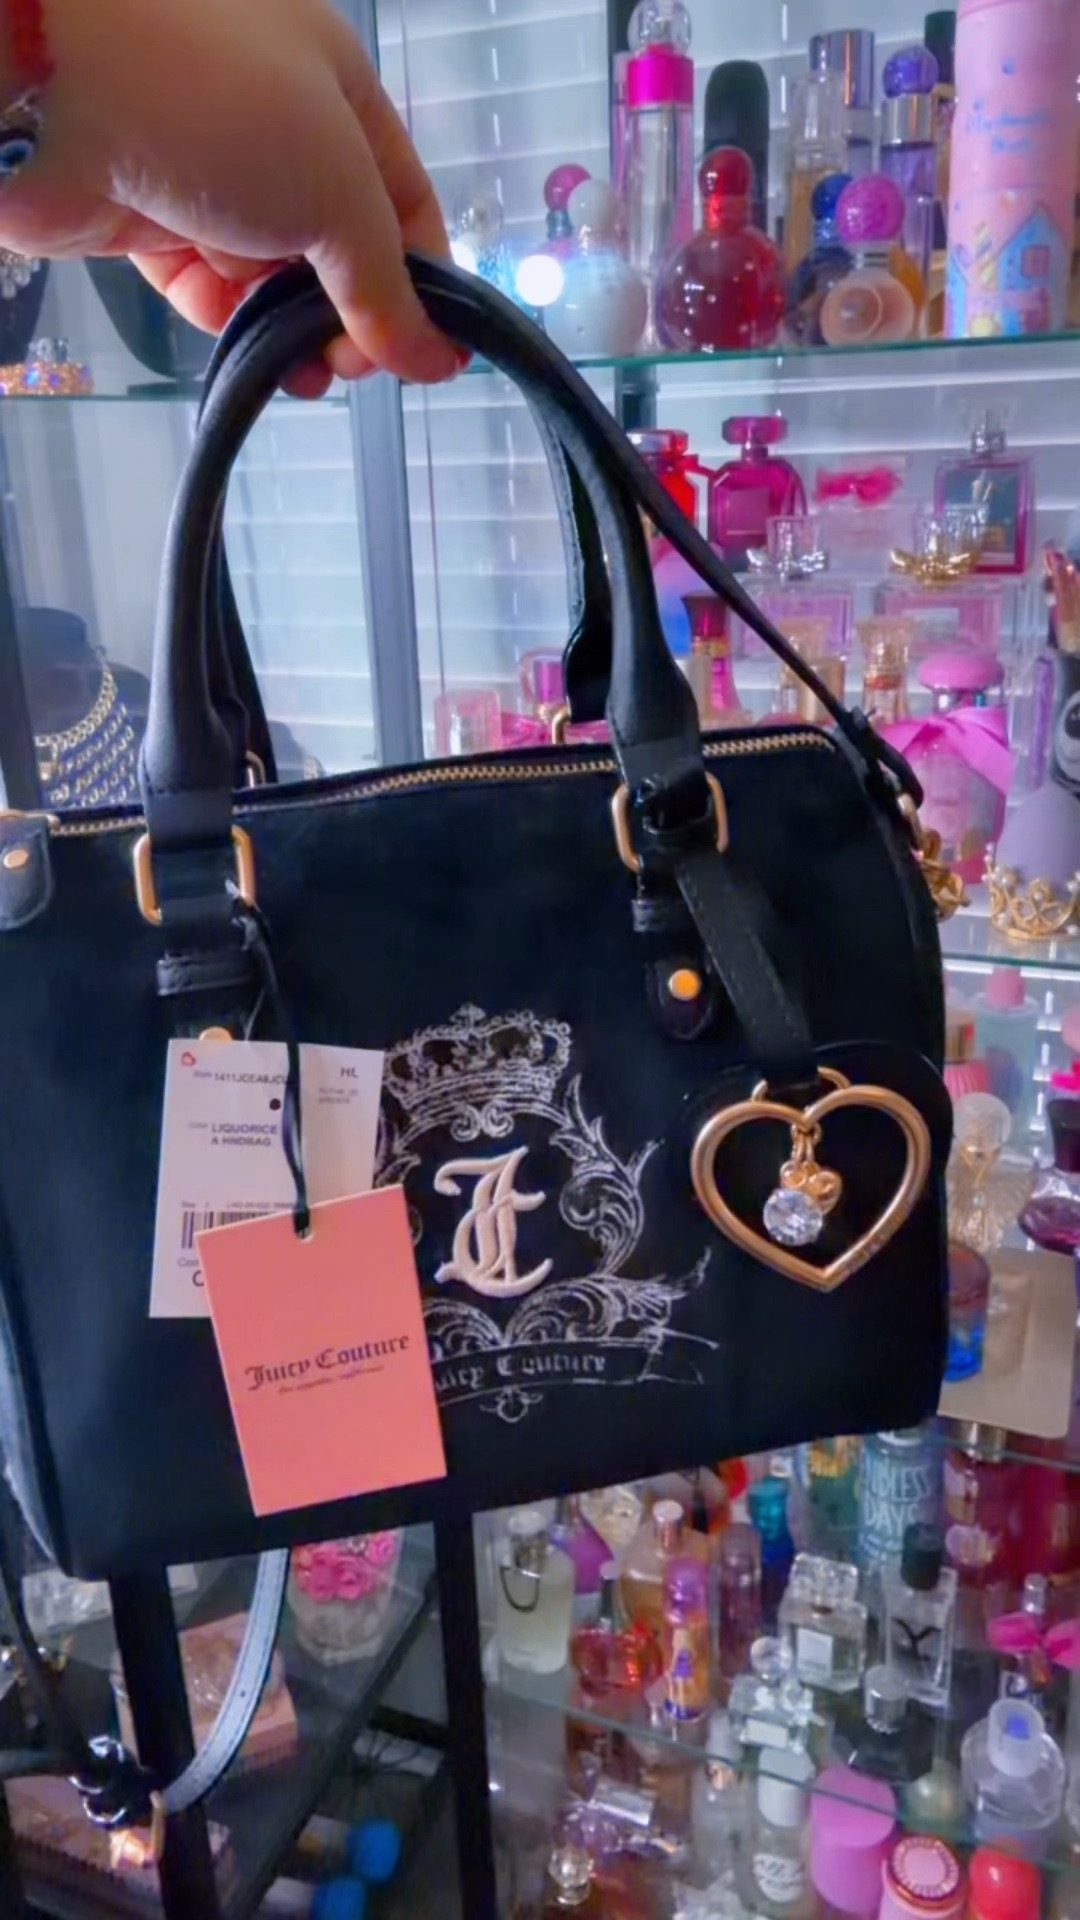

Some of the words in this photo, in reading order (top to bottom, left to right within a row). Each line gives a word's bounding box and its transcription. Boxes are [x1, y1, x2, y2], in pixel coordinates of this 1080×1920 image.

[211, 1123, 278, 1135] LIQUORICE
[211, 1136, 219, 1145] A
[244, 1359, 311, 1391] Juicy
[315, 1335, 409, 1369] Couture
[436, 1367, 484, 1390] uicy
